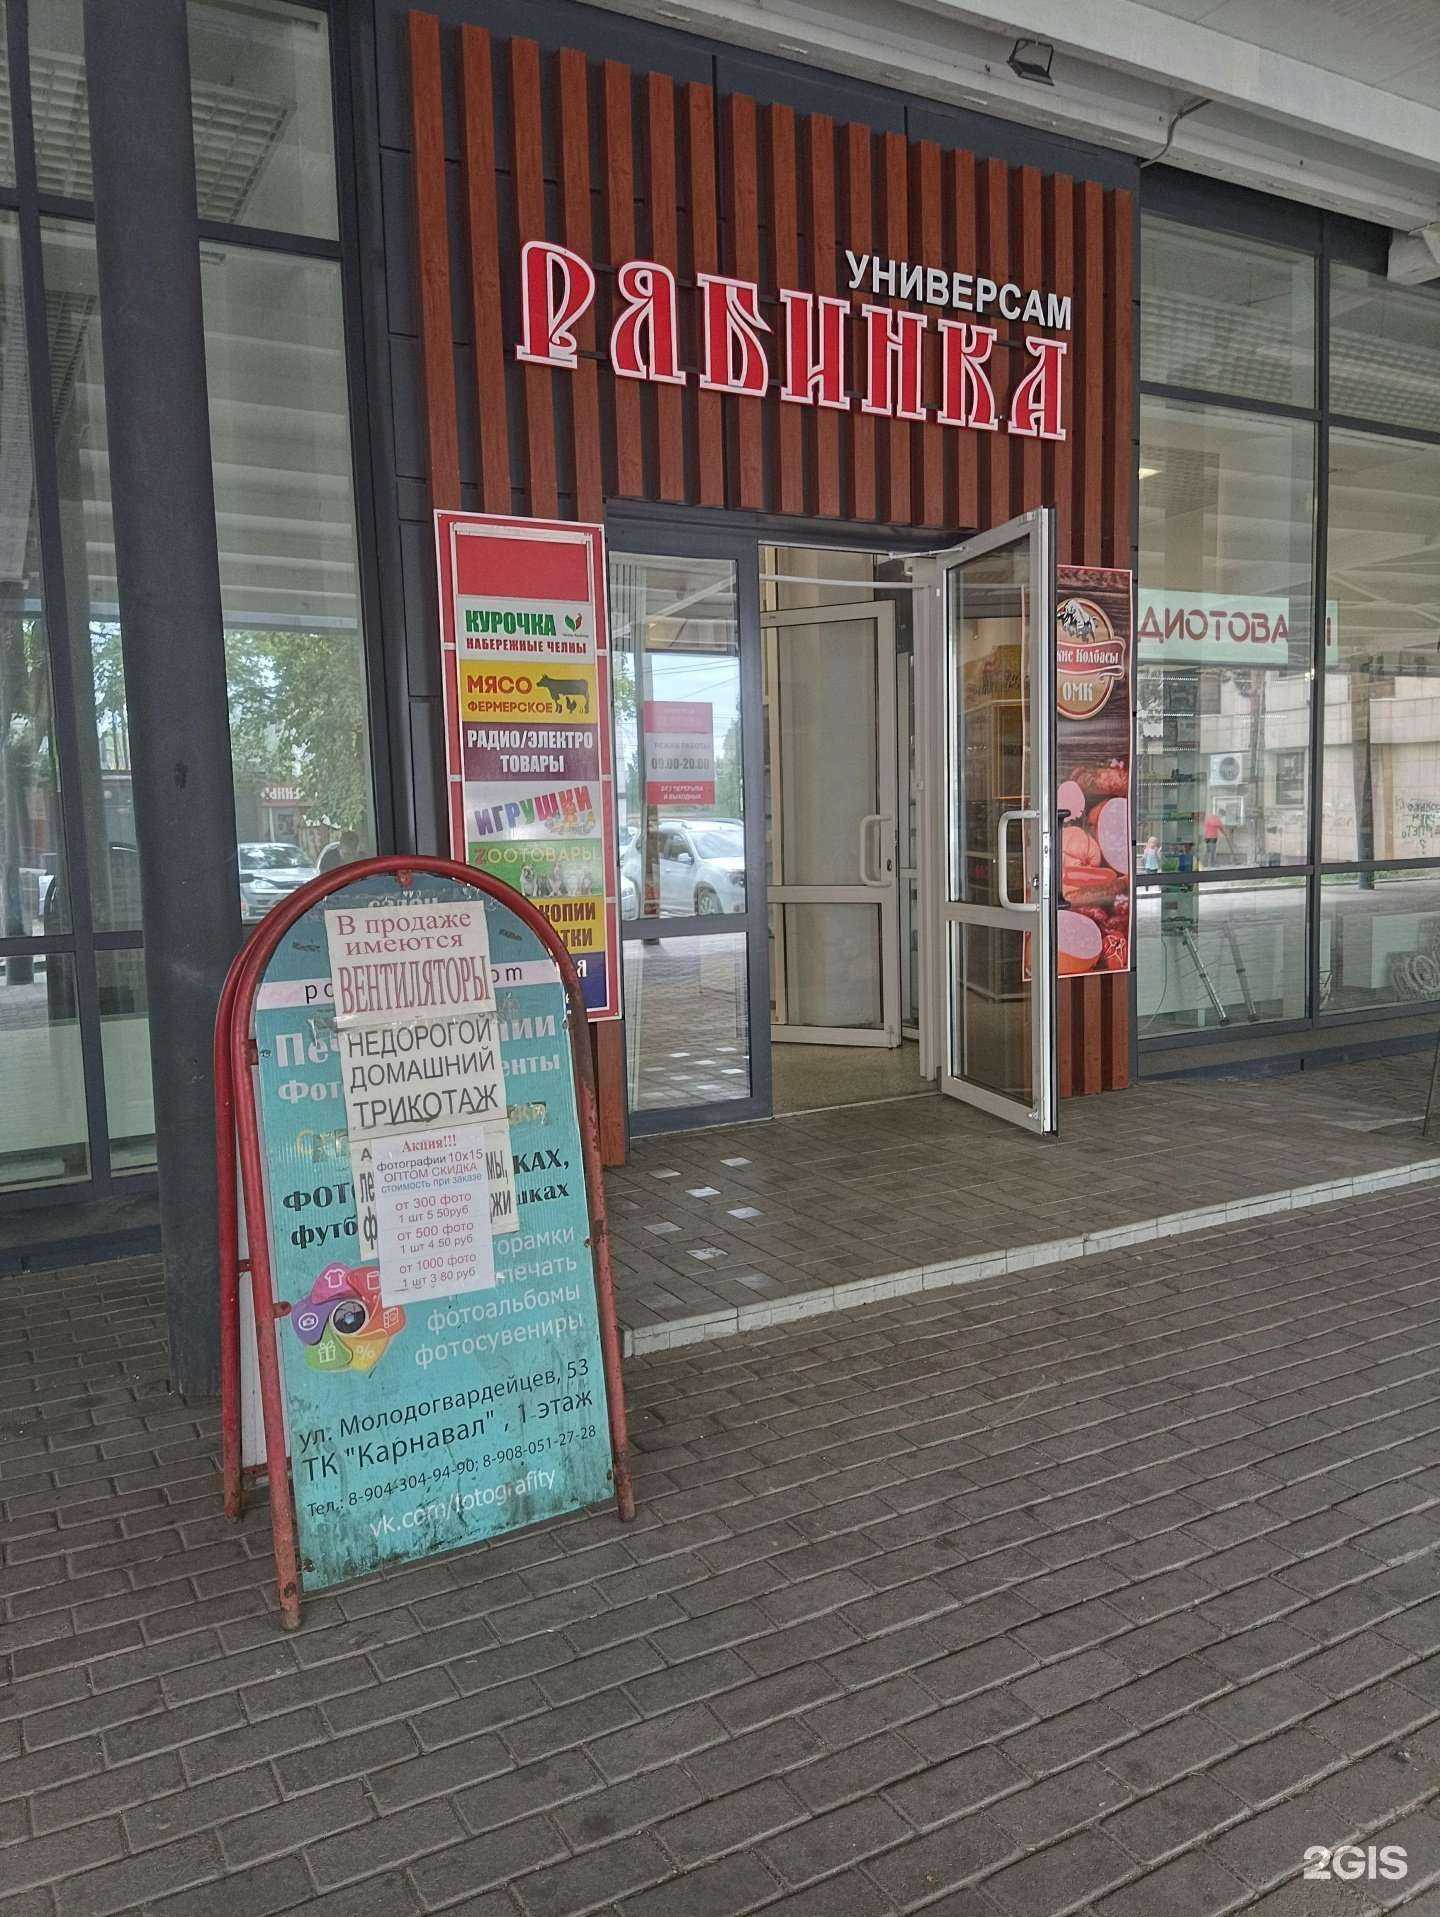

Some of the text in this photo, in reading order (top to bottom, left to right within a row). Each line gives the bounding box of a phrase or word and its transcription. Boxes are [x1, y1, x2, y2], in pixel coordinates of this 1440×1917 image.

[845, 249, 1072, 330] УНИВЕРСАМ
[516, 240, 1068, 440] РЯБИНКА
[465, 610, 557, 636] КУРОЧКА
[1138, 605, 1292, 644] ДИОТОВА
[466, 637, 587, 654] НАБЕРЕЖНЫЕ ЧЕЛНЫ
[1076, 648, 1119, 664] Колбасы
[467, 675, 533, 694] МЯСО
[1063, 682, 1093, 702] ОМК
[467, 700, 553, 714] ФЕРМЕРСКОЕ
[467, 729, 594, 750] РАДИО/ЭЛЕКТРО
[500, 755, 565, 773] ТОВАРЫ
[474, 785, 593, 836] ИГРУШКИ
[336, 913, 471, 938] В продаже
[345, 934, 463, 956] имеются
[338, 956, 492, 1015] ВЕНТИЛЯТОРЫ
[347, 1013, 492, 1059] НЕДОРОГОЙ
[350, 1046, 495, 1093] ДОМАШНИЙ
[353, 1084, 498, 1128] ТРИКОТАЖ
[402, 1134, 457, 1152] Акция!!!
[376, 1155, 447, 1172] фотографии
[384, 1169, 429, 1183] ОПТОМ
[431, 1162, 478, 1177] СКИДКА
[381, 1173, 482, 1193] стоимость при заказе
[395, 1193, 472, 1211] от 300 фото
[408, 1213, 424, 1223] шт
[397, 1222, 474, 1241] от 500 фото
[410, 1243, 424, 1253] шт
[454, 1234, 473, 1247] руб
[399, 1254, 477, 1274] от 1000 фото
[412, 1277, 427, 1287] шт
[456, 1266, 476, 1280] руб
[427, 1284, 580, 1336] фотоальбомы
[415, 1313, 583, 1370] фотосувениры
[299, 1358, 589, 1454] ул. Молодогвардейцев, 53
[302, 1452, 338, 1481] ТК
[518, 1403, 527, 1424] 1
[537, 1390, 593, 1419] этаж
[307, 1424, 597, 1517] Тел.: 8-904-304-94-90; 8-908-051-27-28
